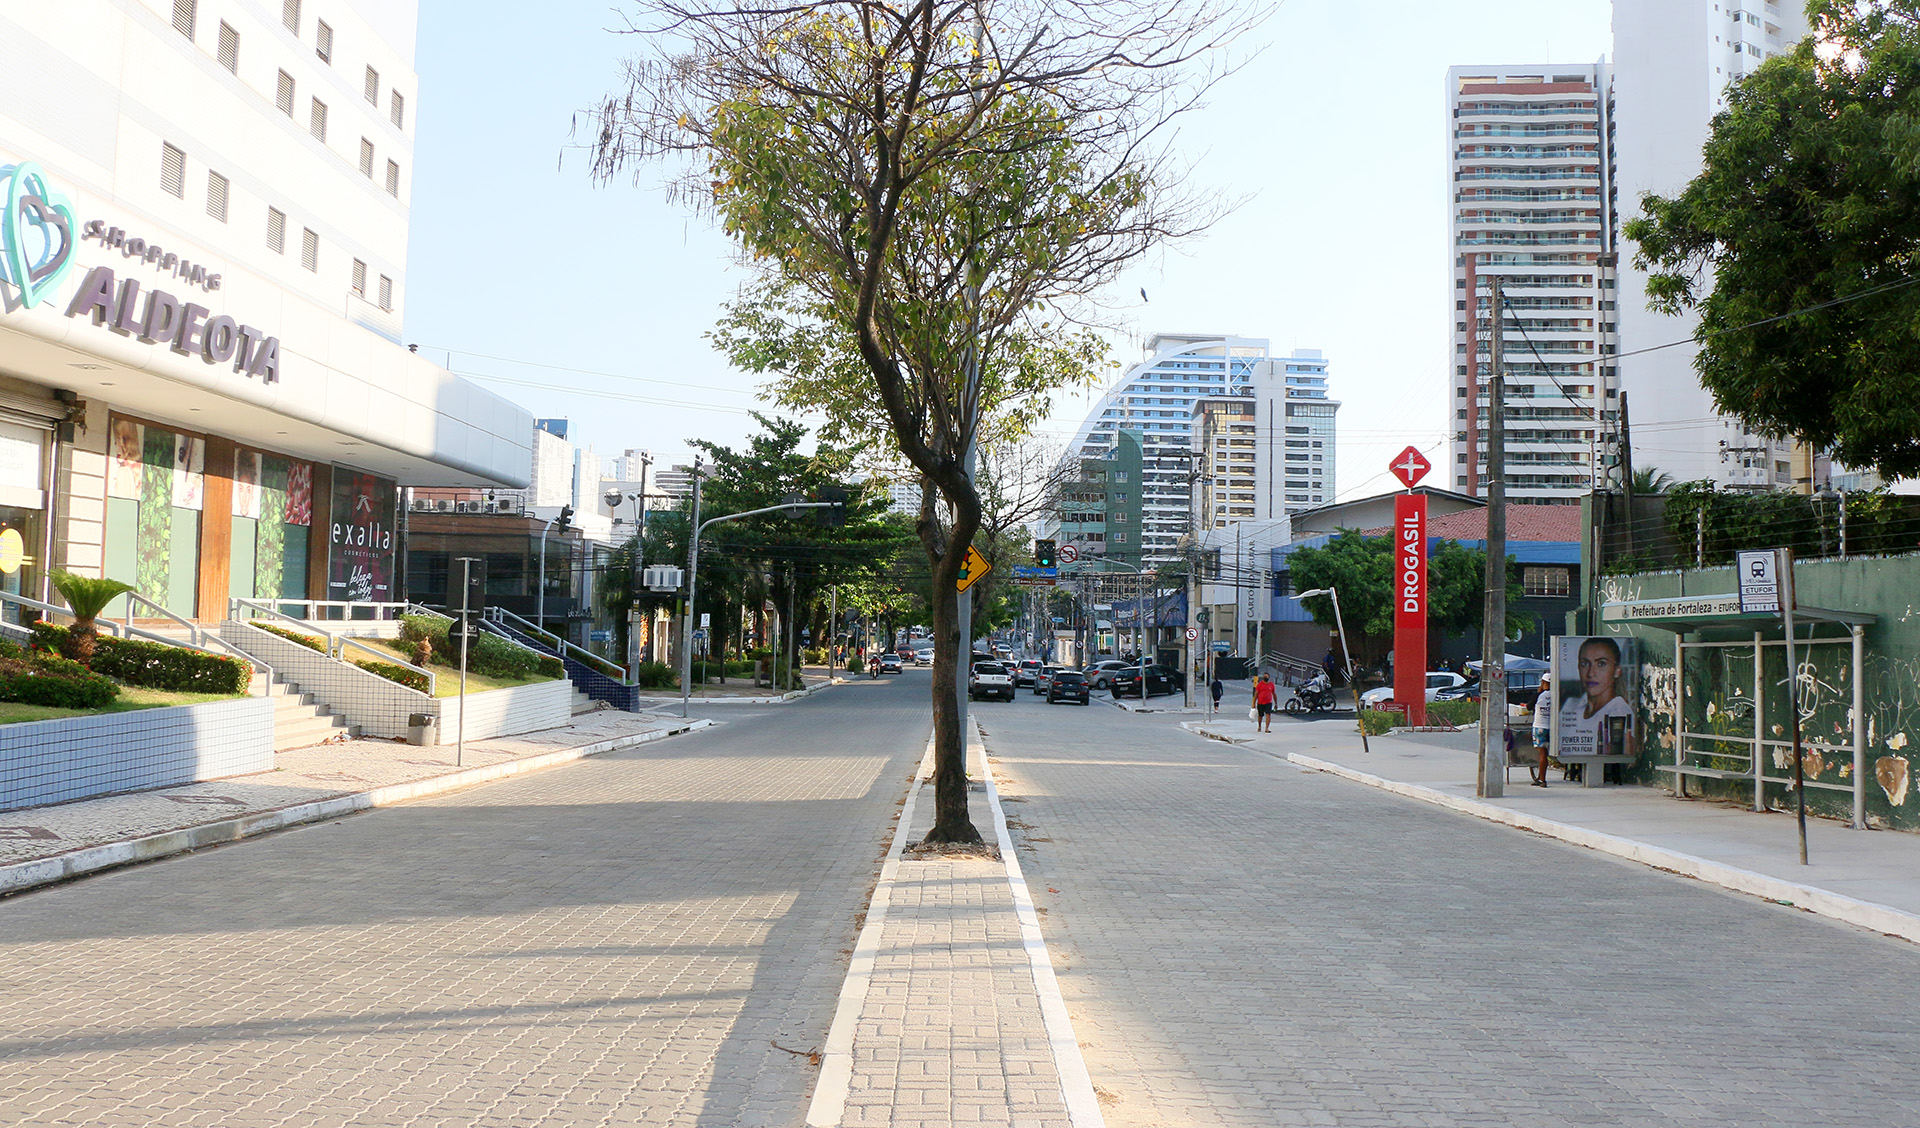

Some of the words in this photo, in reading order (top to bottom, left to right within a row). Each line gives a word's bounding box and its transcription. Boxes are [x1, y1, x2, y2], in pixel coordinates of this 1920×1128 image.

[82, 220, 222, 292] SHOPPING
[64, 266, 280, 385] ALDEOTA
[332, 521, 390, 549] exalla
[1403, 511, 1419, 612] DROGASIL
[1632, 606, 1665, 617] Prefeitura
[1667, 604, 1676, 615] de
[1678, 602, 1712, 614] Fortaleza
[1718, 602, 1740, 612] ETUFOR
